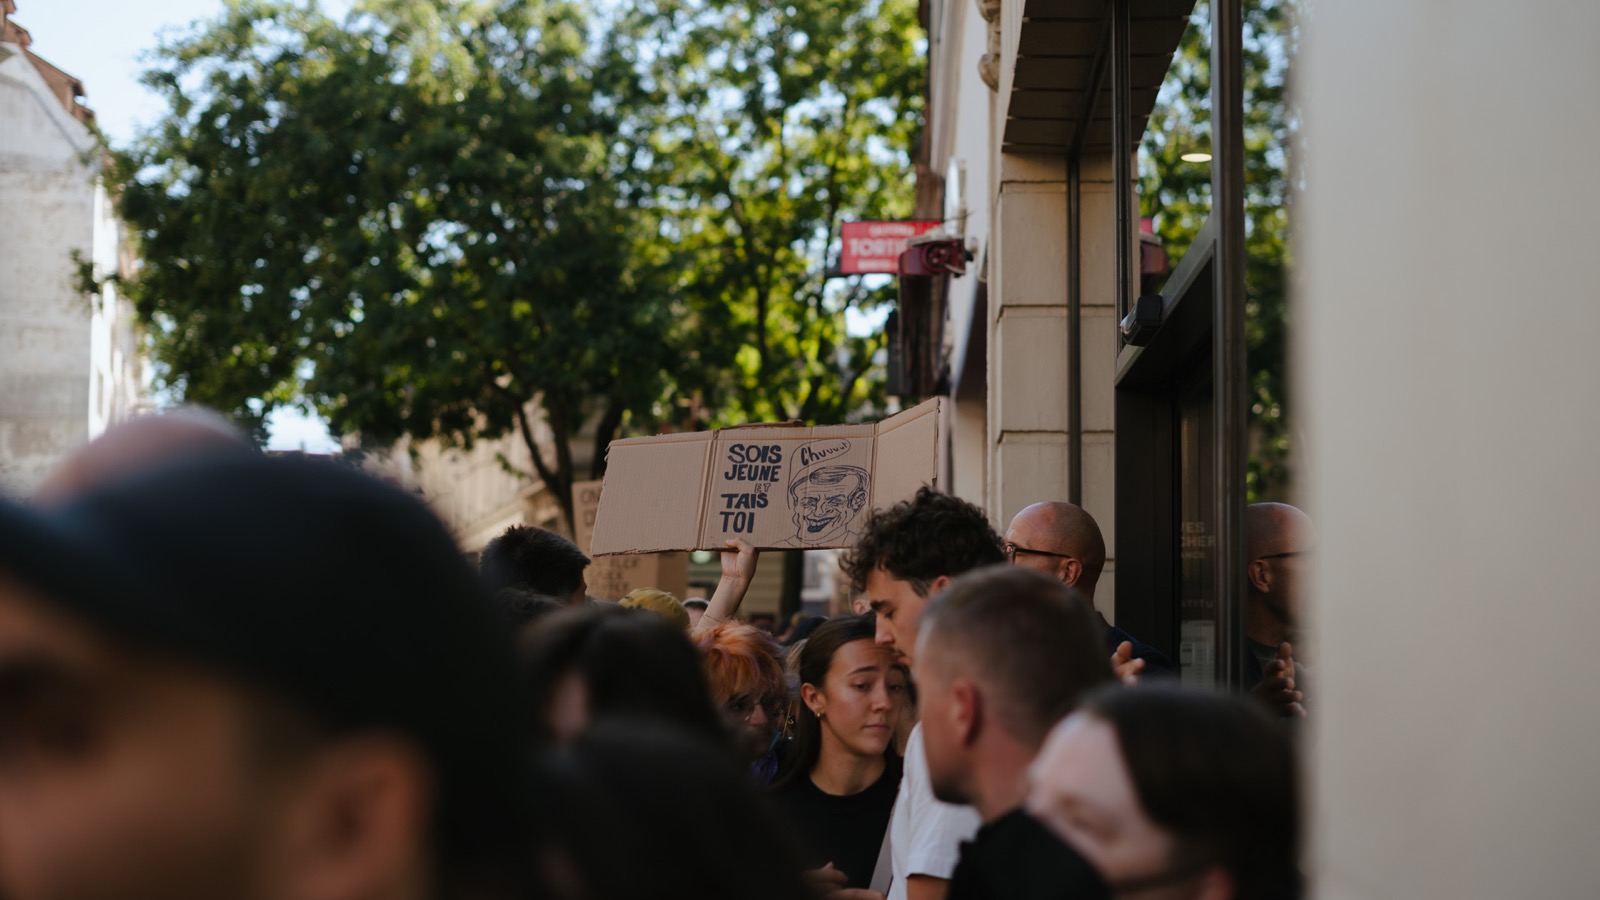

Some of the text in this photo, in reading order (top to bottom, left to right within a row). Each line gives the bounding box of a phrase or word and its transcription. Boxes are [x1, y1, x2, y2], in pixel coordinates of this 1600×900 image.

[727, 443, 782, 464] SOIS
[724, 464, 781, 482] JEUNE
[754, 483, 771, 493] ET
[720, 492, 769, 509] TAIS
[719, 511, 755, 533] TOI
